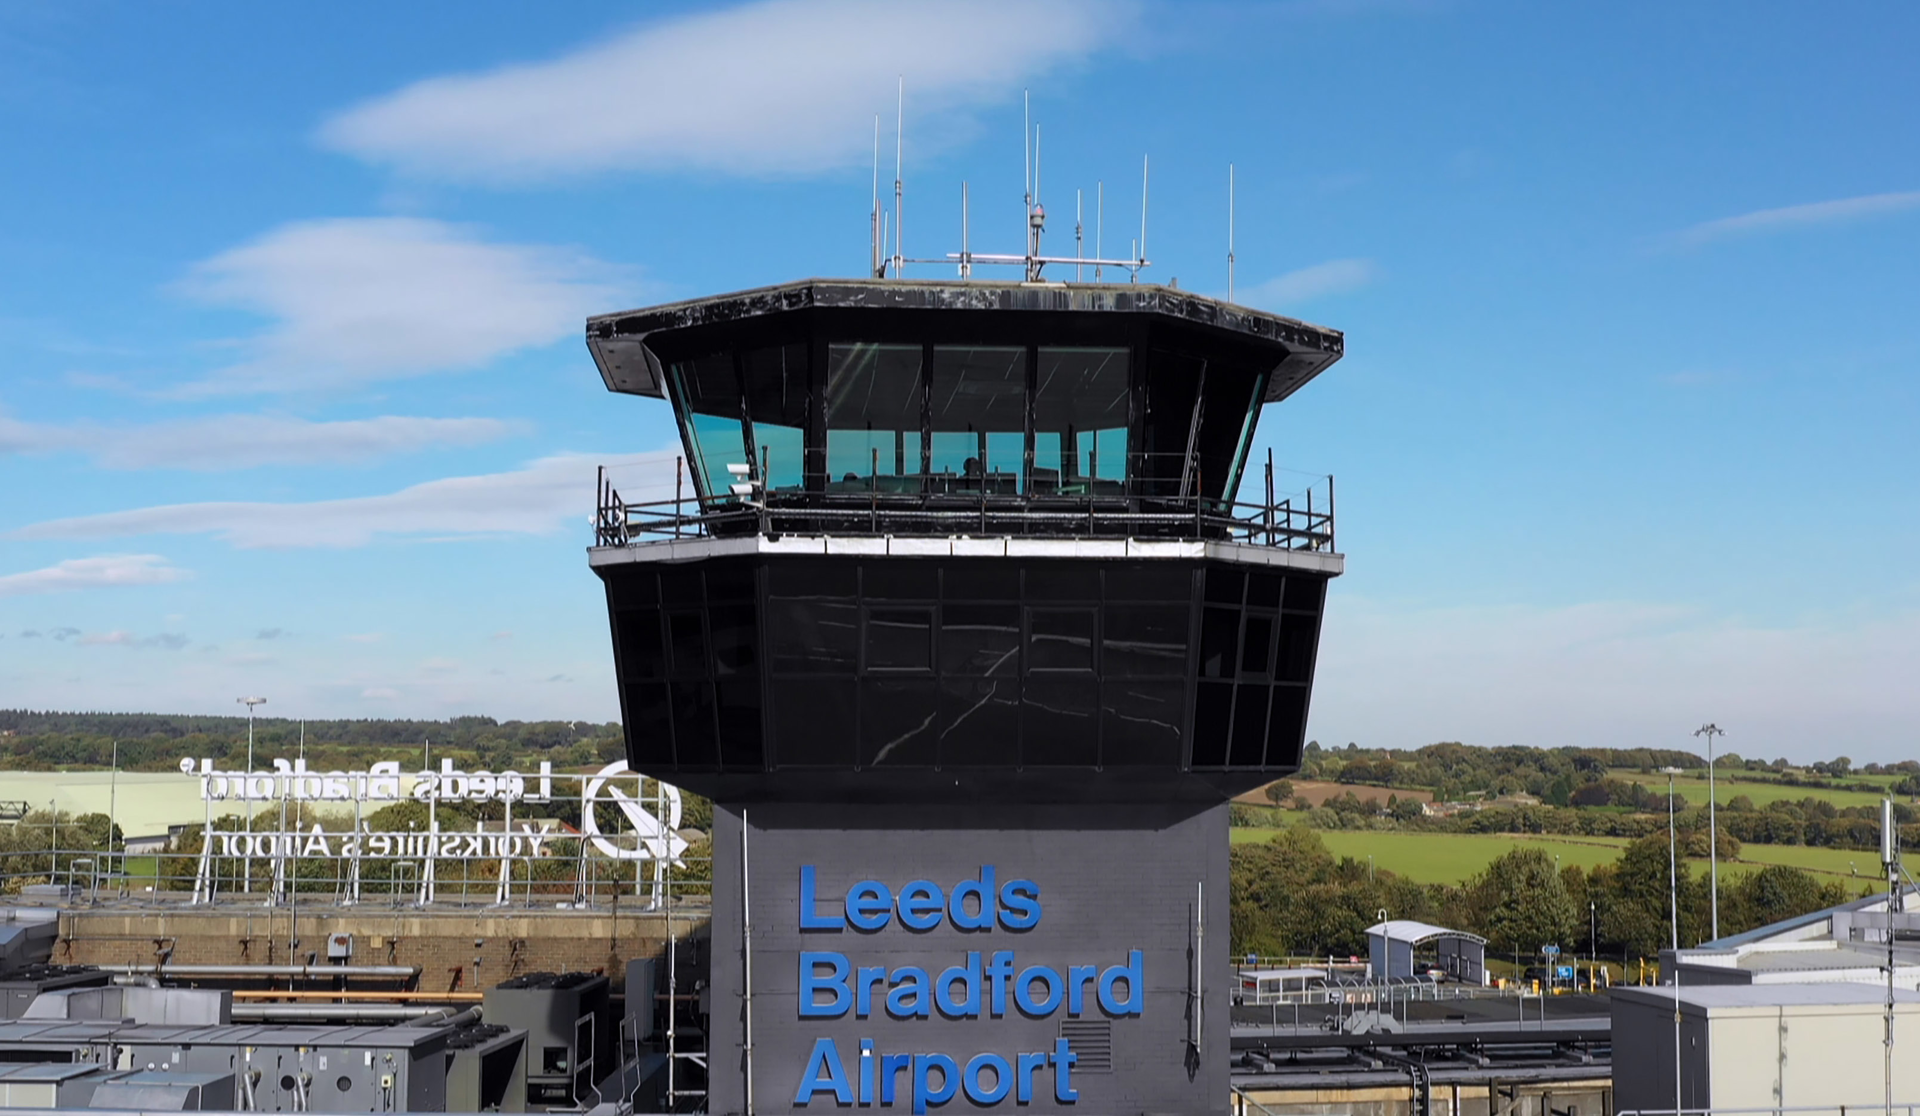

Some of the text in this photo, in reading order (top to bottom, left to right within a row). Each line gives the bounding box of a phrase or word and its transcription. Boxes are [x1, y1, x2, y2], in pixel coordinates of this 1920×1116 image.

[799, 864, 1042, 930] Leeds
[798, 949, 1144, 1017] Bradford
[794, 1036, 1079, 1115] Airport
